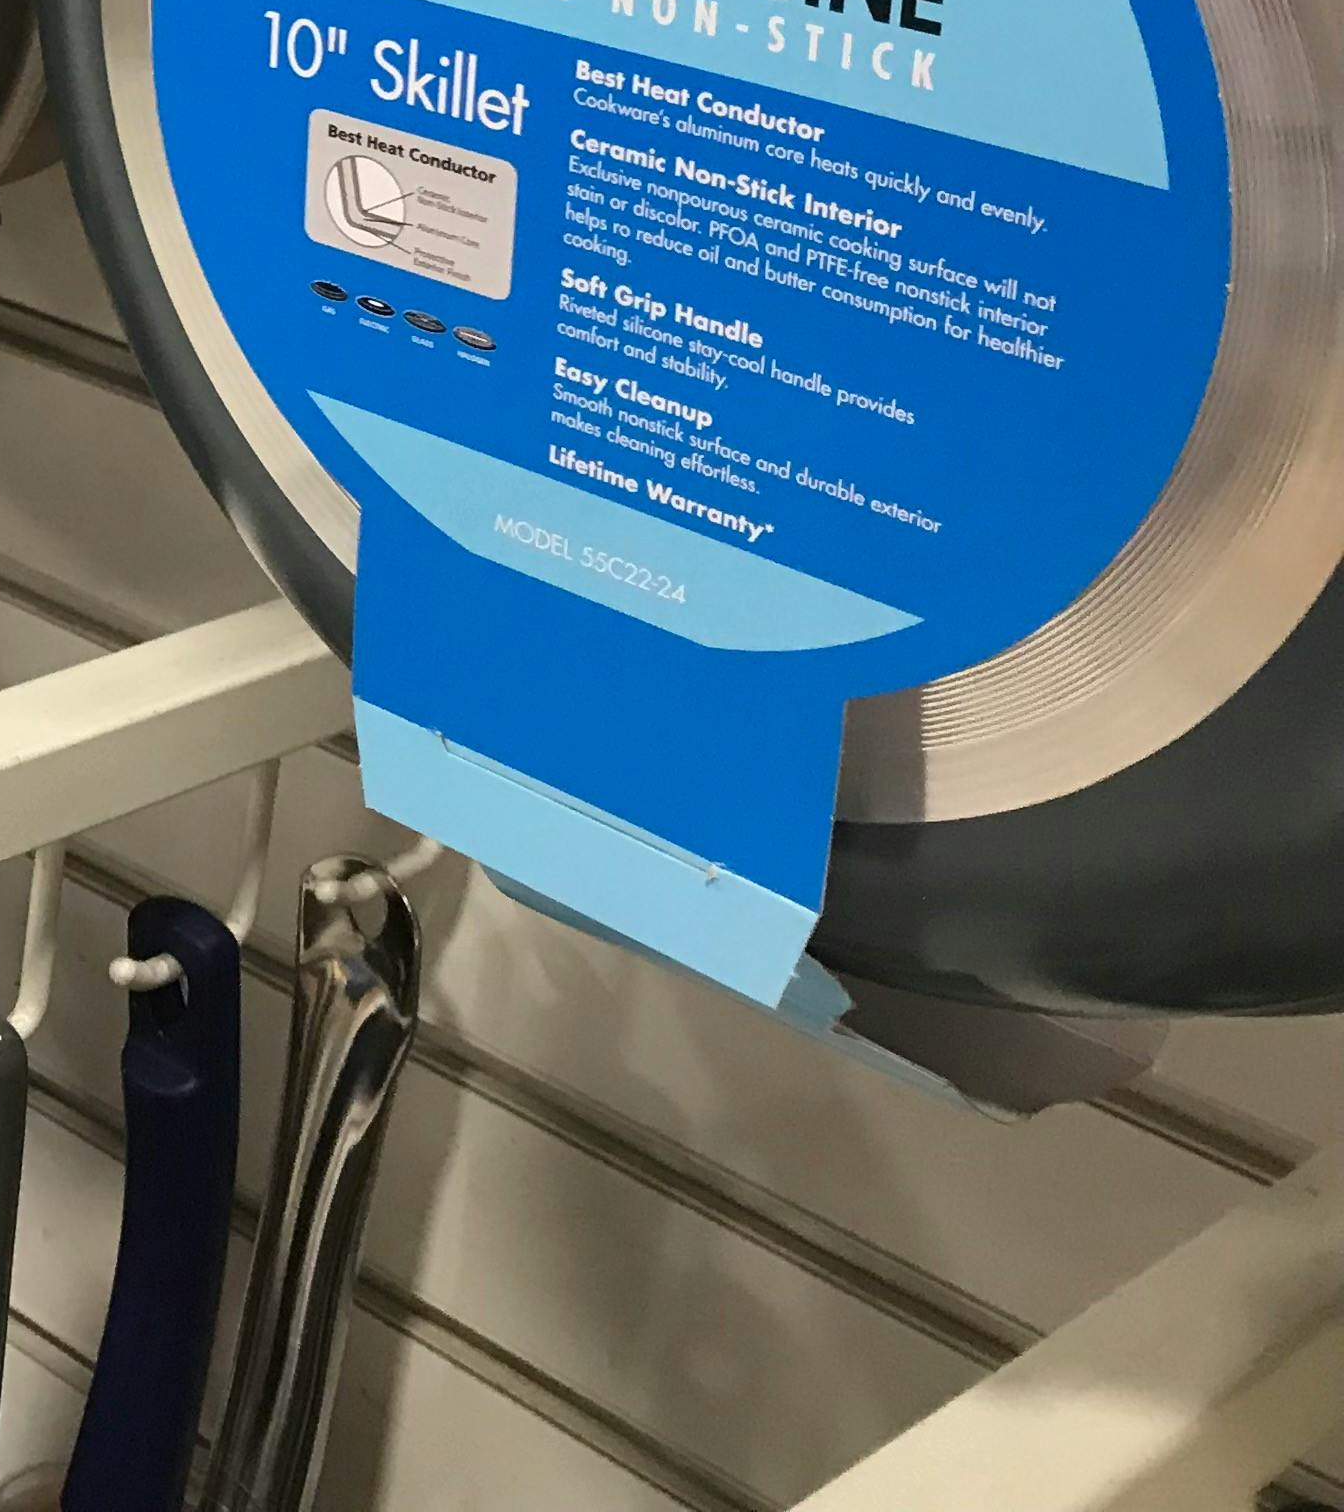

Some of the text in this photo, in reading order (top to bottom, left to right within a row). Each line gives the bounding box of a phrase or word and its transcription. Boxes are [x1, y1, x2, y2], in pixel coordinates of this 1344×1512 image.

[264, 10, 530, 136] 10" Skillet
[575, 59, 826, 143] Best Heat Conductor
[328, 124, 497, 185] Best Heat Conductor
[570, 129, 903, 239] Ceramic Non-Stick Interior
[573, 86, 1048, 235] Cookware's aluminum core heats quickly and evenly.
[562, 231, 632, 267] cooking.
[566, 183, 1049, 337] stain or discolor. PFOA and PTFE-free nonstick interior
[568, 154, 1057, 312] Exclusive nonpourous ceramic cooking surface will not
[560, 267, 764, 349] Soft Grip Handle
[564, 201, 608, 233] helps
[635, 227, 693, 257] reduce
[698, 245, 720, 265] oil
[724, 256, 760, 276] and
[764, 259, 817, 292] butter
[821, 282, 938, 331] consumption
[944, 313, 972, 341] for
[977, 324, 1065, 371] healthier
[554, 356, 714, 430] Easy Cleanup
[556, 321, 729, 391] comfort and stability.
[558, 292, 915, 426] Riveted silicone stay-cool handle provides
[548, 443, 639, 494] Lifetime
[550, 410, 761, 496] makes cleaning effortless.
[552, 383, 942, 534] Smooth nonstick surface and durable exterior
[493, 513, 688, 605] MODEL 55C22-24
